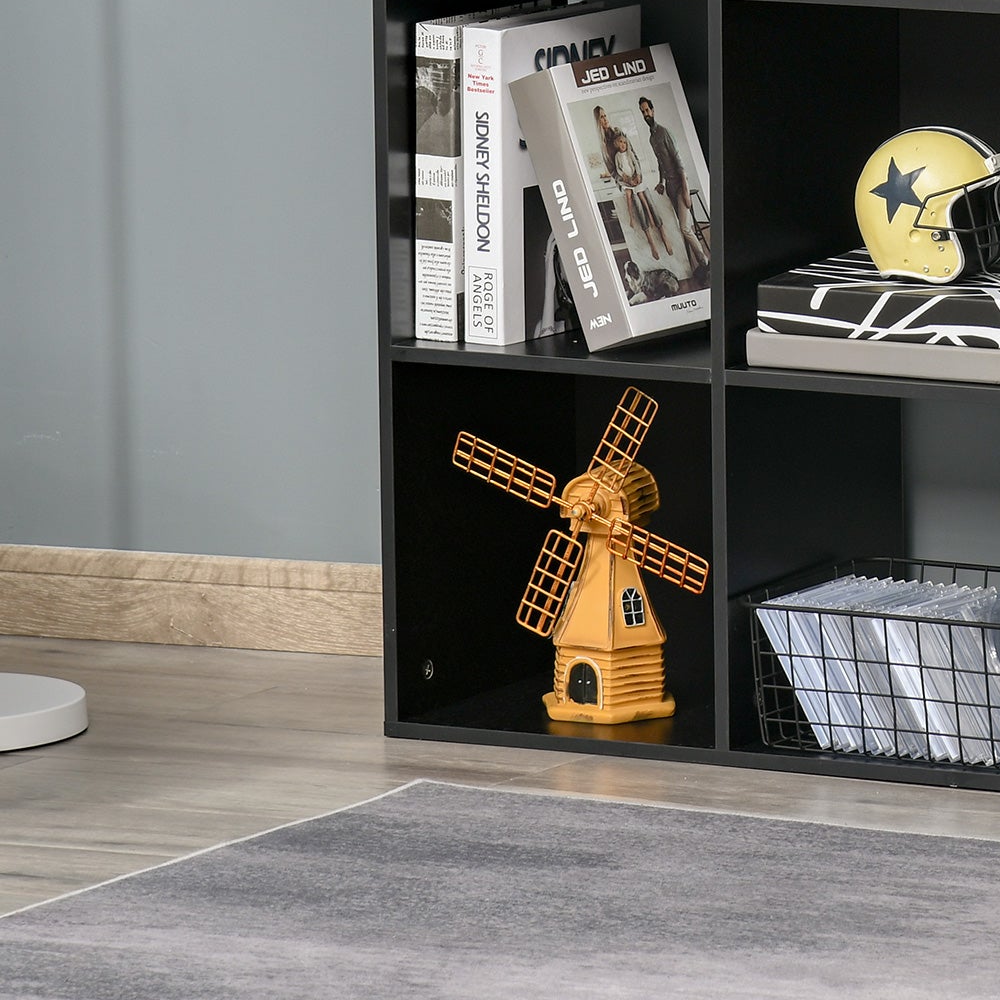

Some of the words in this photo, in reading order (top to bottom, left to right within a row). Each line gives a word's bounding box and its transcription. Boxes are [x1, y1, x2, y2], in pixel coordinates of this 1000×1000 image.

[467, 86, 495, 94] Bestseller
[581, 66, 609, 84] JED
[613, 59, 647, 77] LIND
[475, 111, 490, 170] SIDNEY
[476, 172, 491, 252] SHELDON
[552, 179, 579, 239] LIND
[573, 246, 599, 298] JED
[472, 273, 483, 328] ANGELS
[483, 315, 494, 334] OF
[590, 312, 613, 331] NEW
